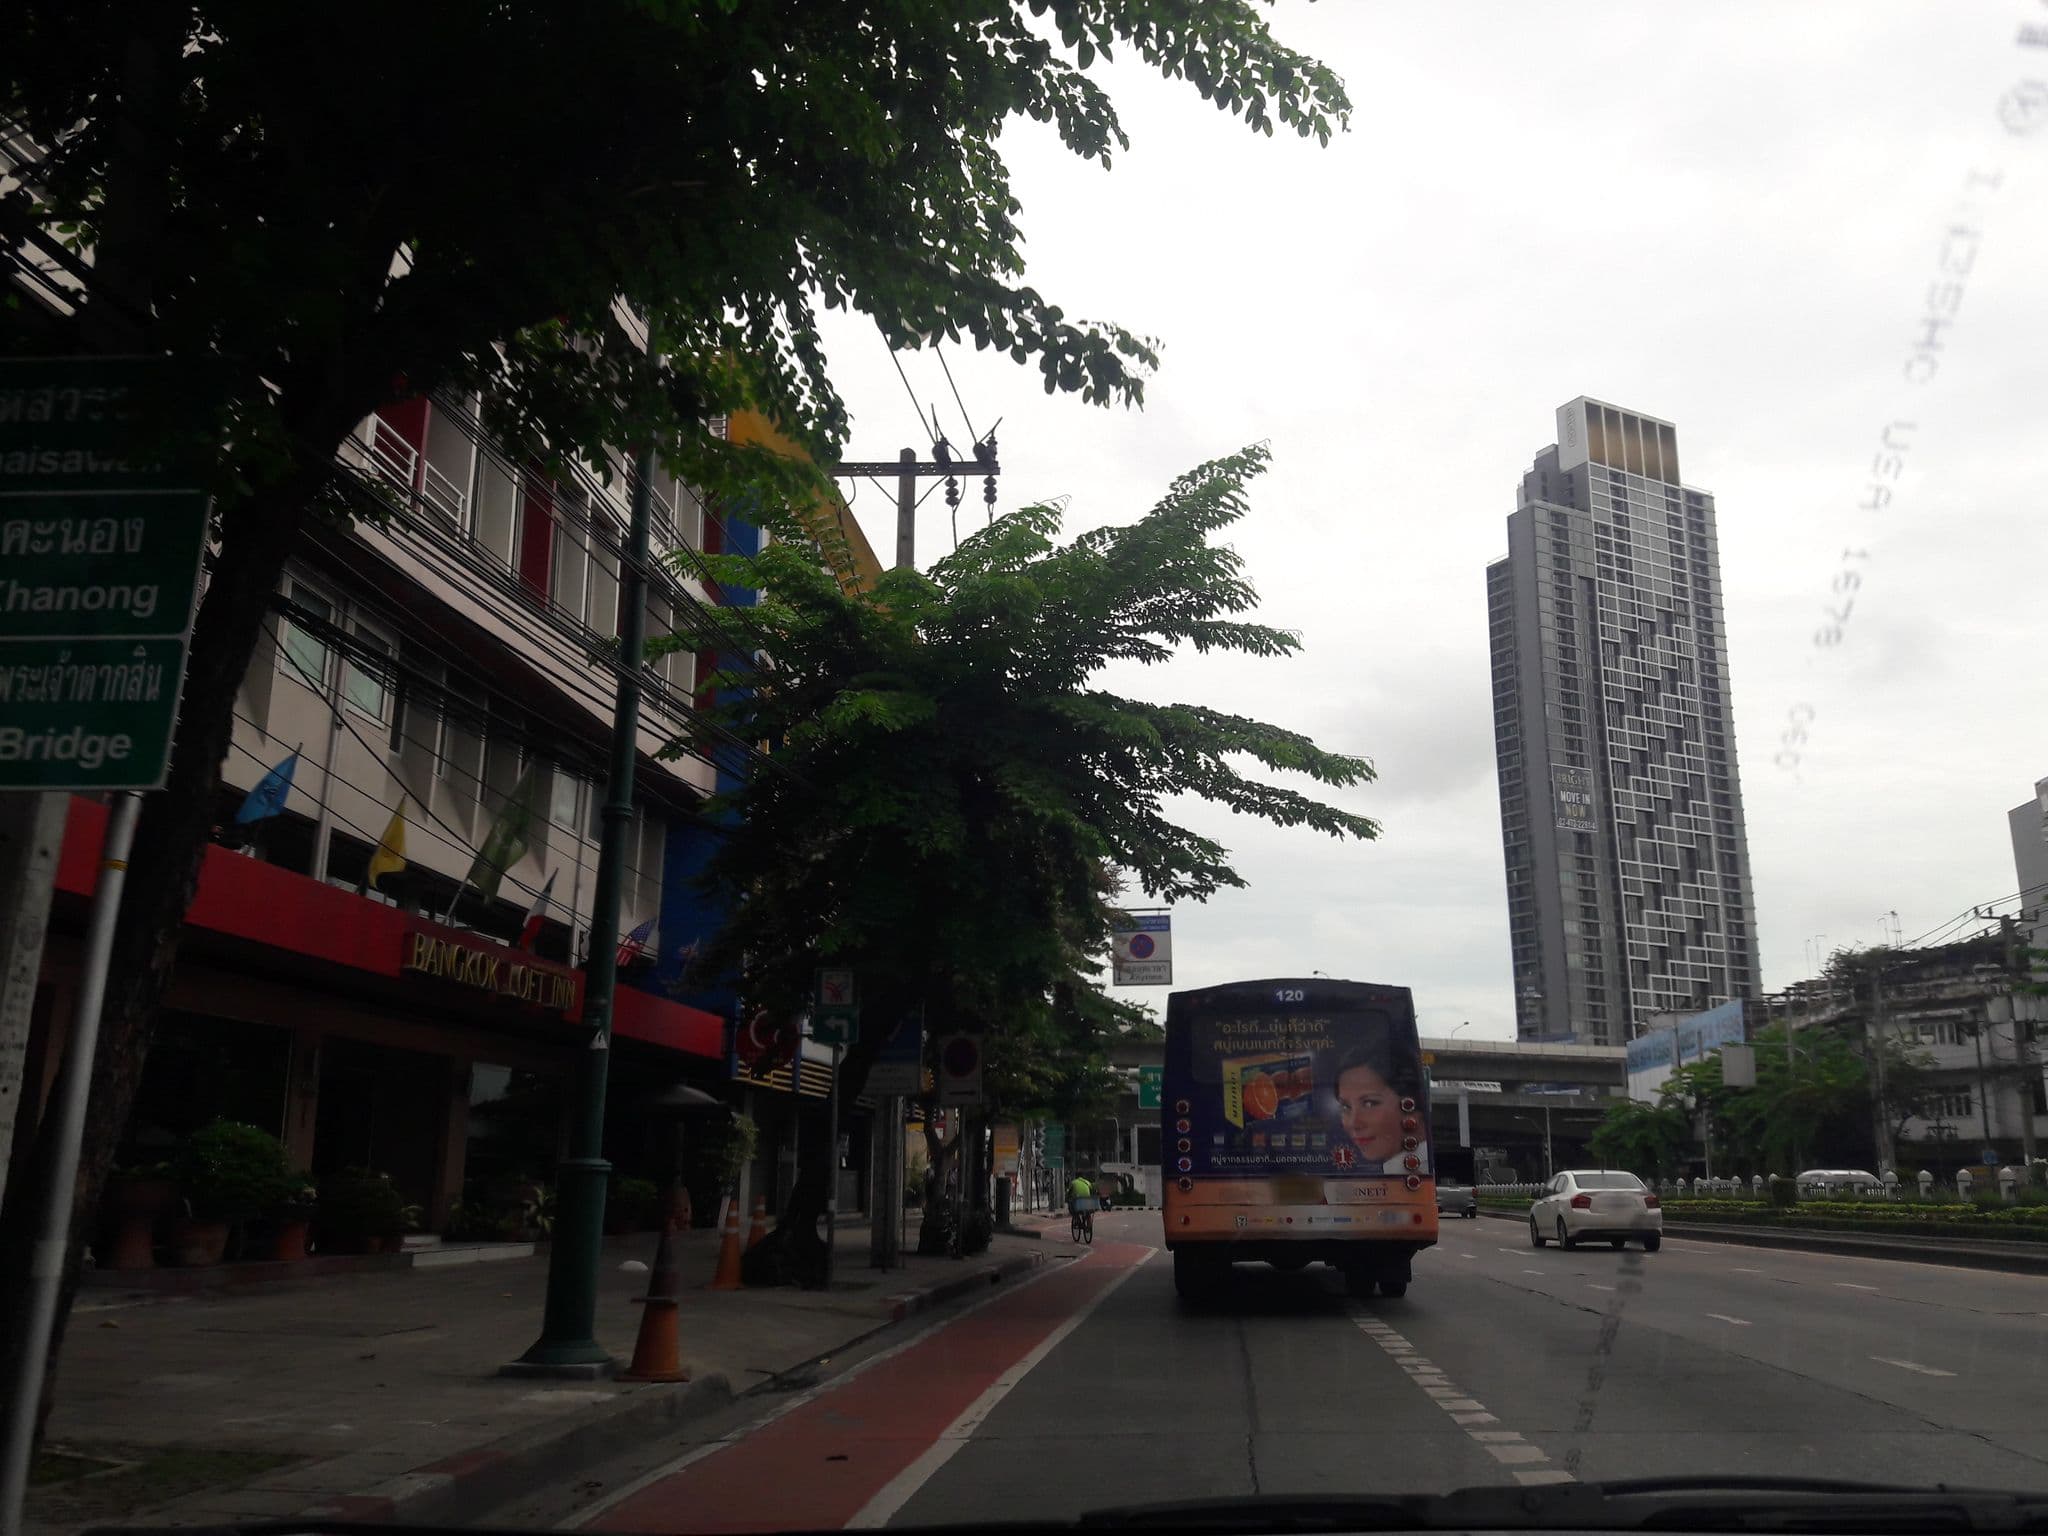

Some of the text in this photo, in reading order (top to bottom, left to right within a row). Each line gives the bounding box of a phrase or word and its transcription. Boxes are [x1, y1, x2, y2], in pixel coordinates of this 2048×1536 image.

[0, 726, 133, 769] Bridge
[1560, 790, 1591, 805] MOVE IN
[1565, 803, 1586, 817] NOW
[413, 932, 577, 1008] BANGKOK LOFT INN
[1275, 989, 1305, 1003] 120
